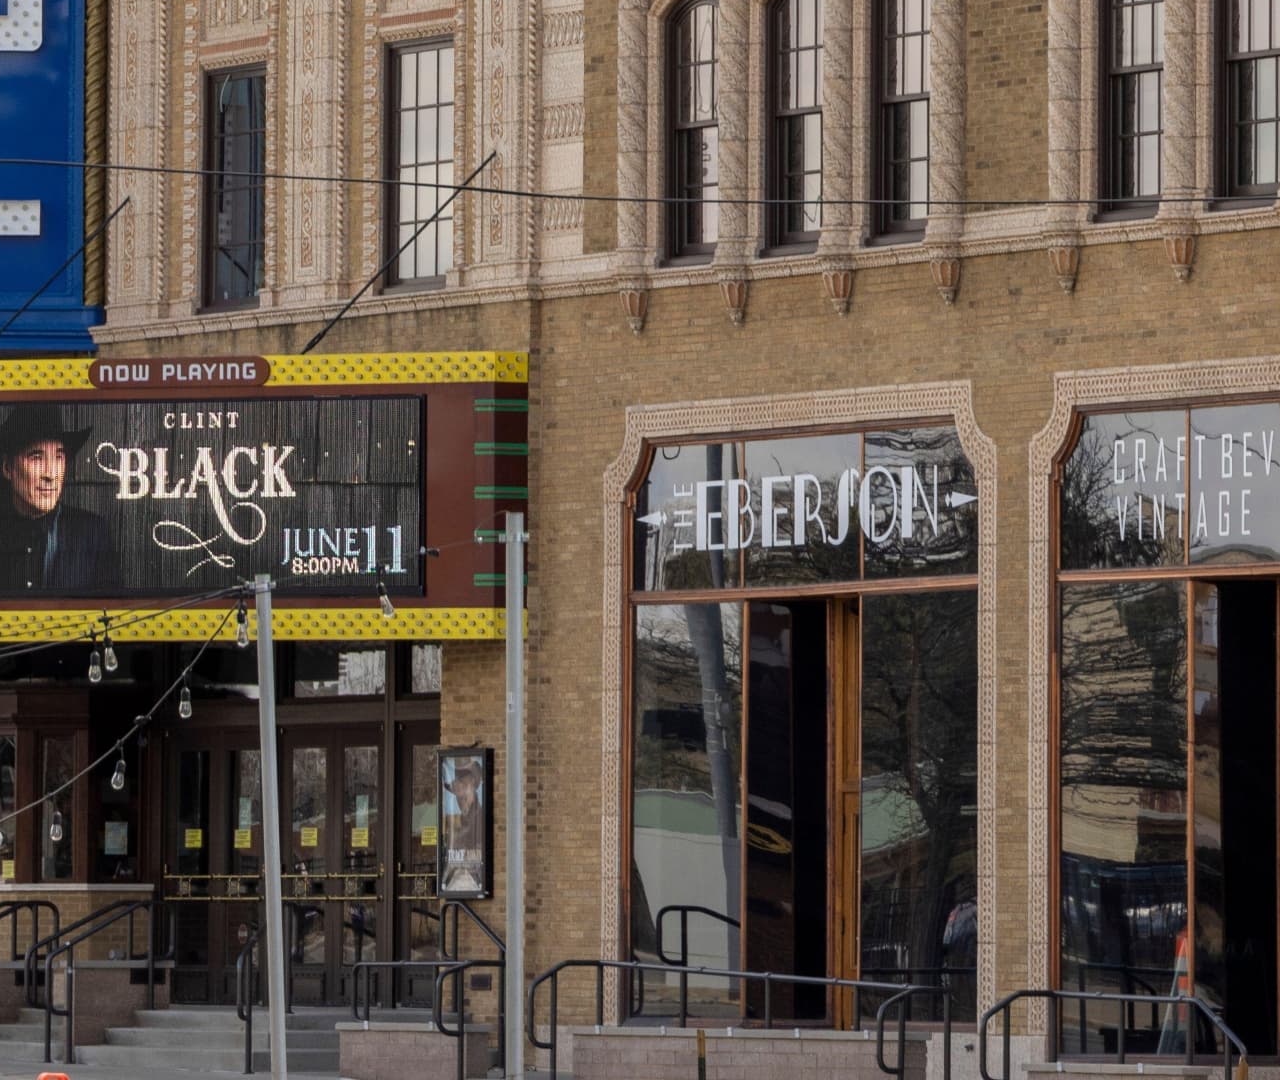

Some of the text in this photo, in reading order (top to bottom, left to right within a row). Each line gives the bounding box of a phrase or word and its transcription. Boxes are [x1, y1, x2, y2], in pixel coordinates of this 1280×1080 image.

[99, 362, 257, 382] NOW PLAYING
[164, 412, 239, 429] CLINT
[1114, 435, 1206, 484] CRAFT
[95, 442, 297, 544] BLACK
[673, 464, 938, 553] THE EBERSON
[1116, 489, 1251, 542] VINTAGE
[282, 525, 407, 573] JUNE 11
[292, 556, 359, 575] 8:00PM
